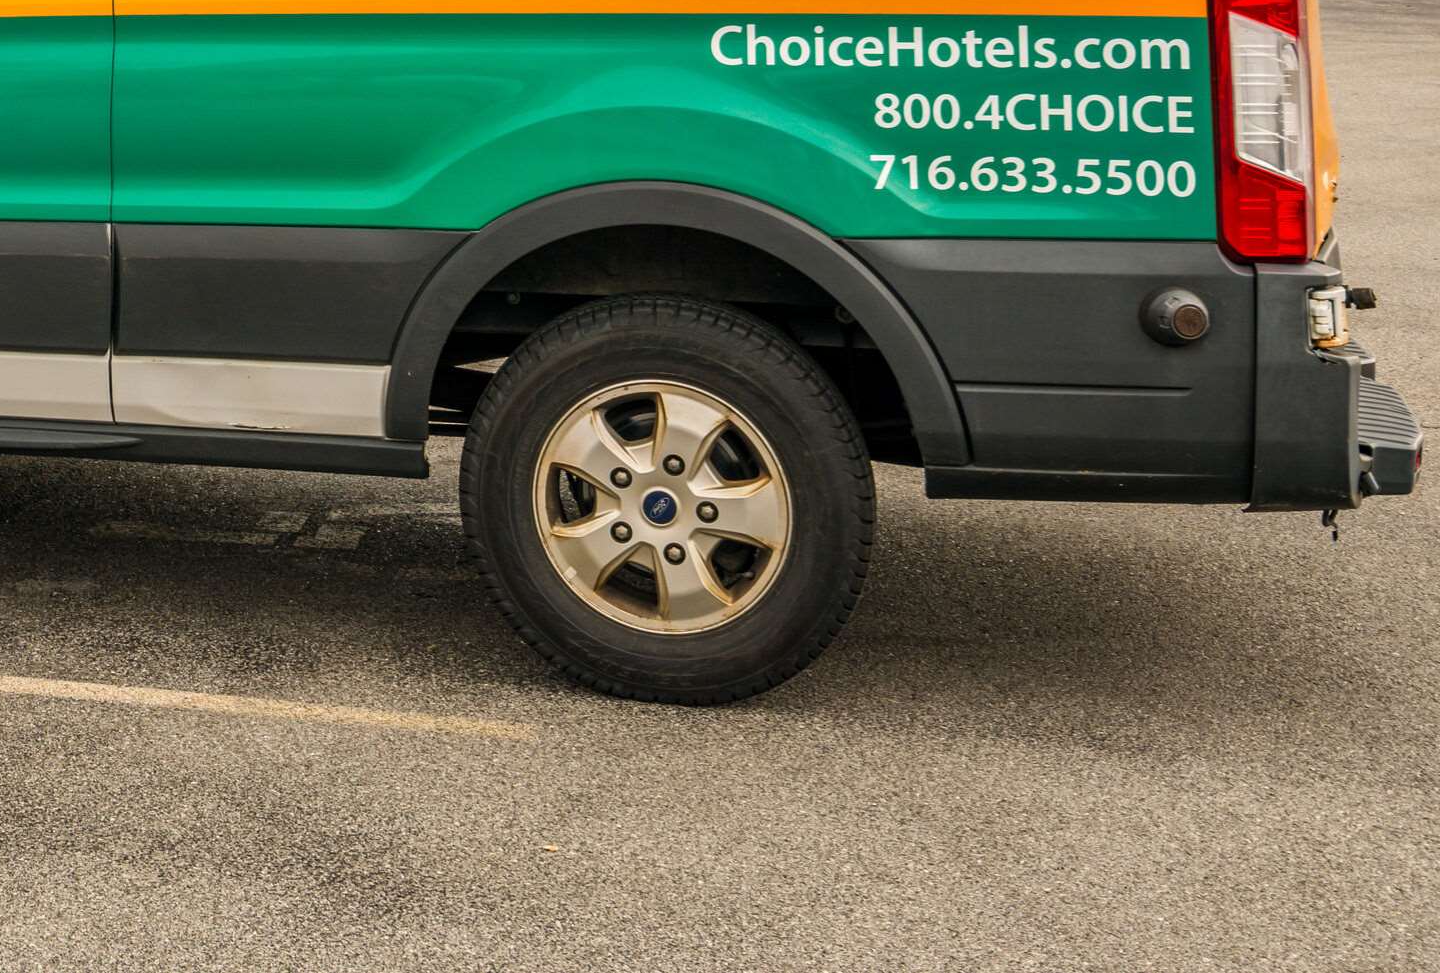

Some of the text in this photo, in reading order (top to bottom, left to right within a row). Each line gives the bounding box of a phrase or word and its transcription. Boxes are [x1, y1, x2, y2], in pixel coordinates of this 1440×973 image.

[710, 24, 1191, 69] ChoiceHotels.com
[873, 93, 1195, 133] 800.4CHOICE
[869, 154, 1196, 198] 716.633.5500
